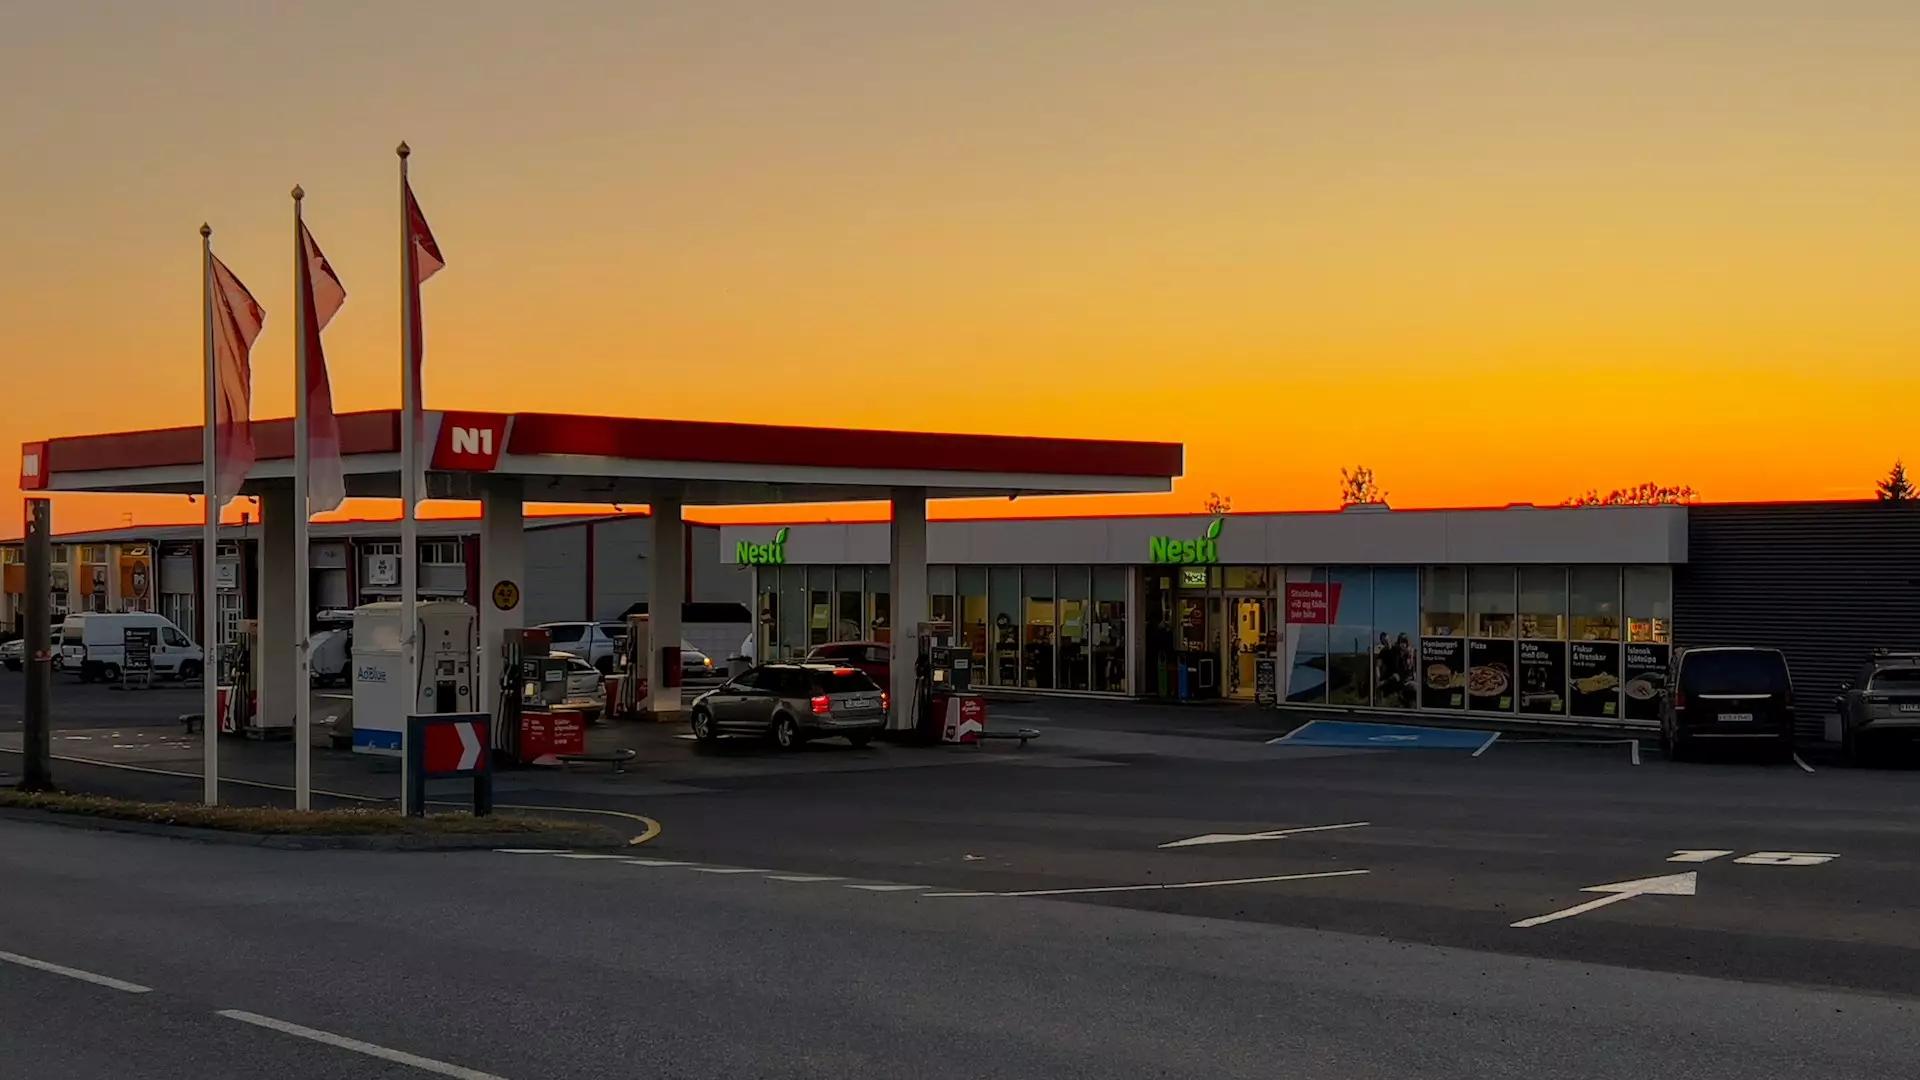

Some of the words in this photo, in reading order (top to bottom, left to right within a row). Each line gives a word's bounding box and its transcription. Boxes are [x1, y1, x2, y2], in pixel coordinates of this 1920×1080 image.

[452, 427, 492, 455] N1
[736, 530, 788, 564] Nesti
[1150, 521, 1222, 563] Nesti
[1470, 641, 1487, 650] Pizza
[1521, 643, 1539, 652] Pylsa
[1572, 645, 1594, 653] Fiskur
[358, 664, 386, 681] AdBlue
